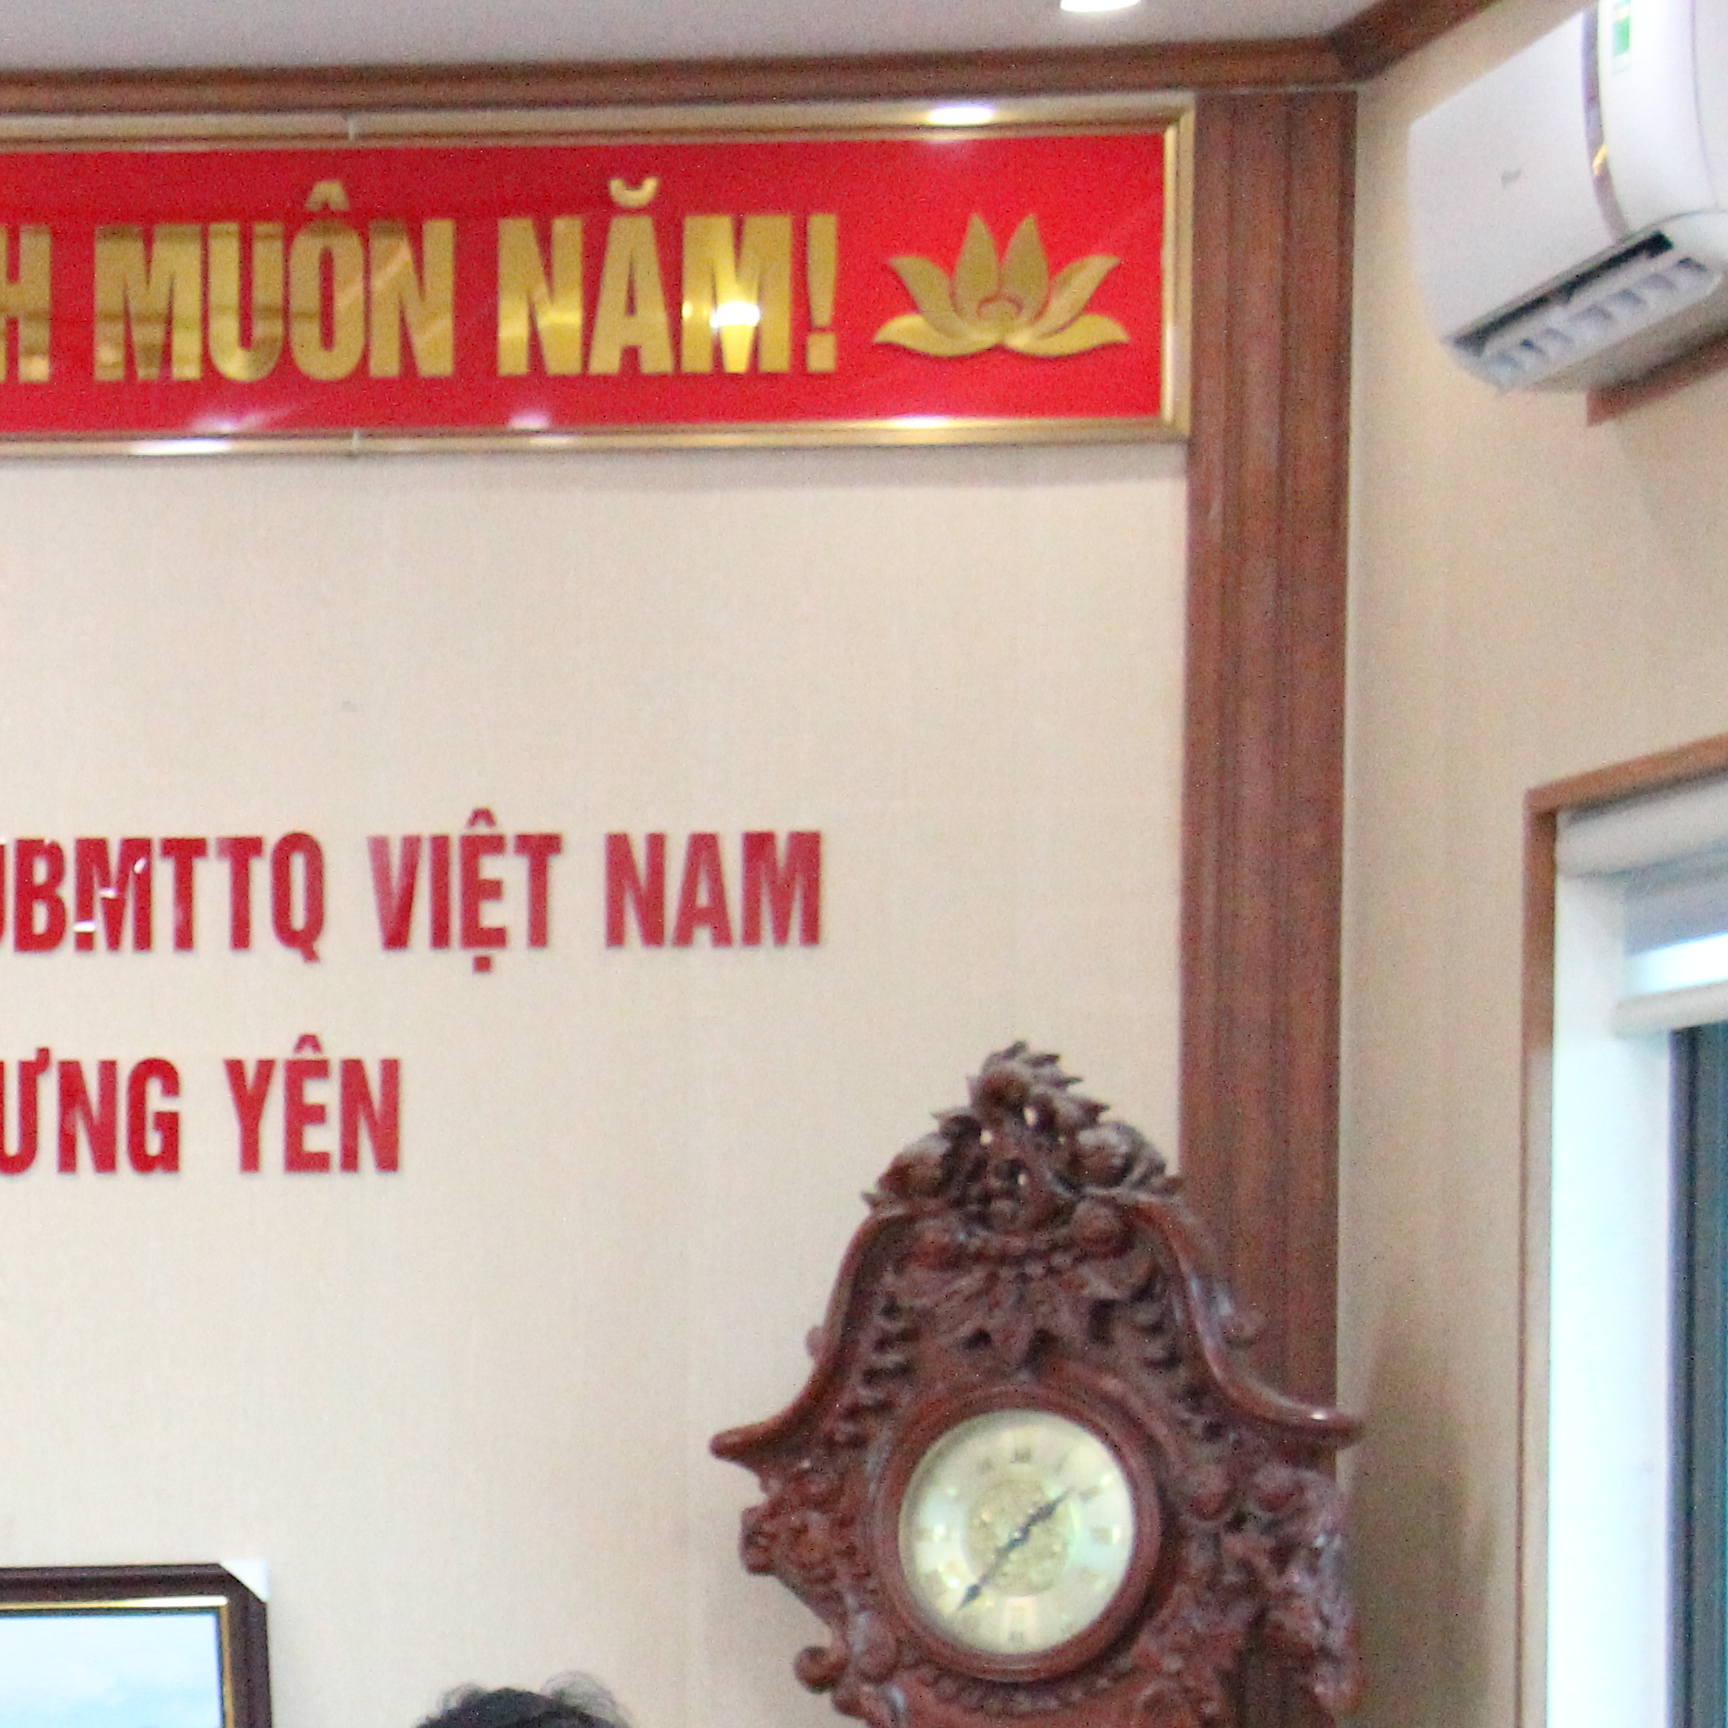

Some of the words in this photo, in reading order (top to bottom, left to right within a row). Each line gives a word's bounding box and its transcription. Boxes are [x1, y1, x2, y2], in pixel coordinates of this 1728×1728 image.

[94, 180, 455, 383] MUÔN
[497, 176, 839, 377] NĂM!
[368, 807, 563, 974] VIỆT
[605, 830, 824, 949] NAM
[223, 1033, 402, 1174] YÊN
